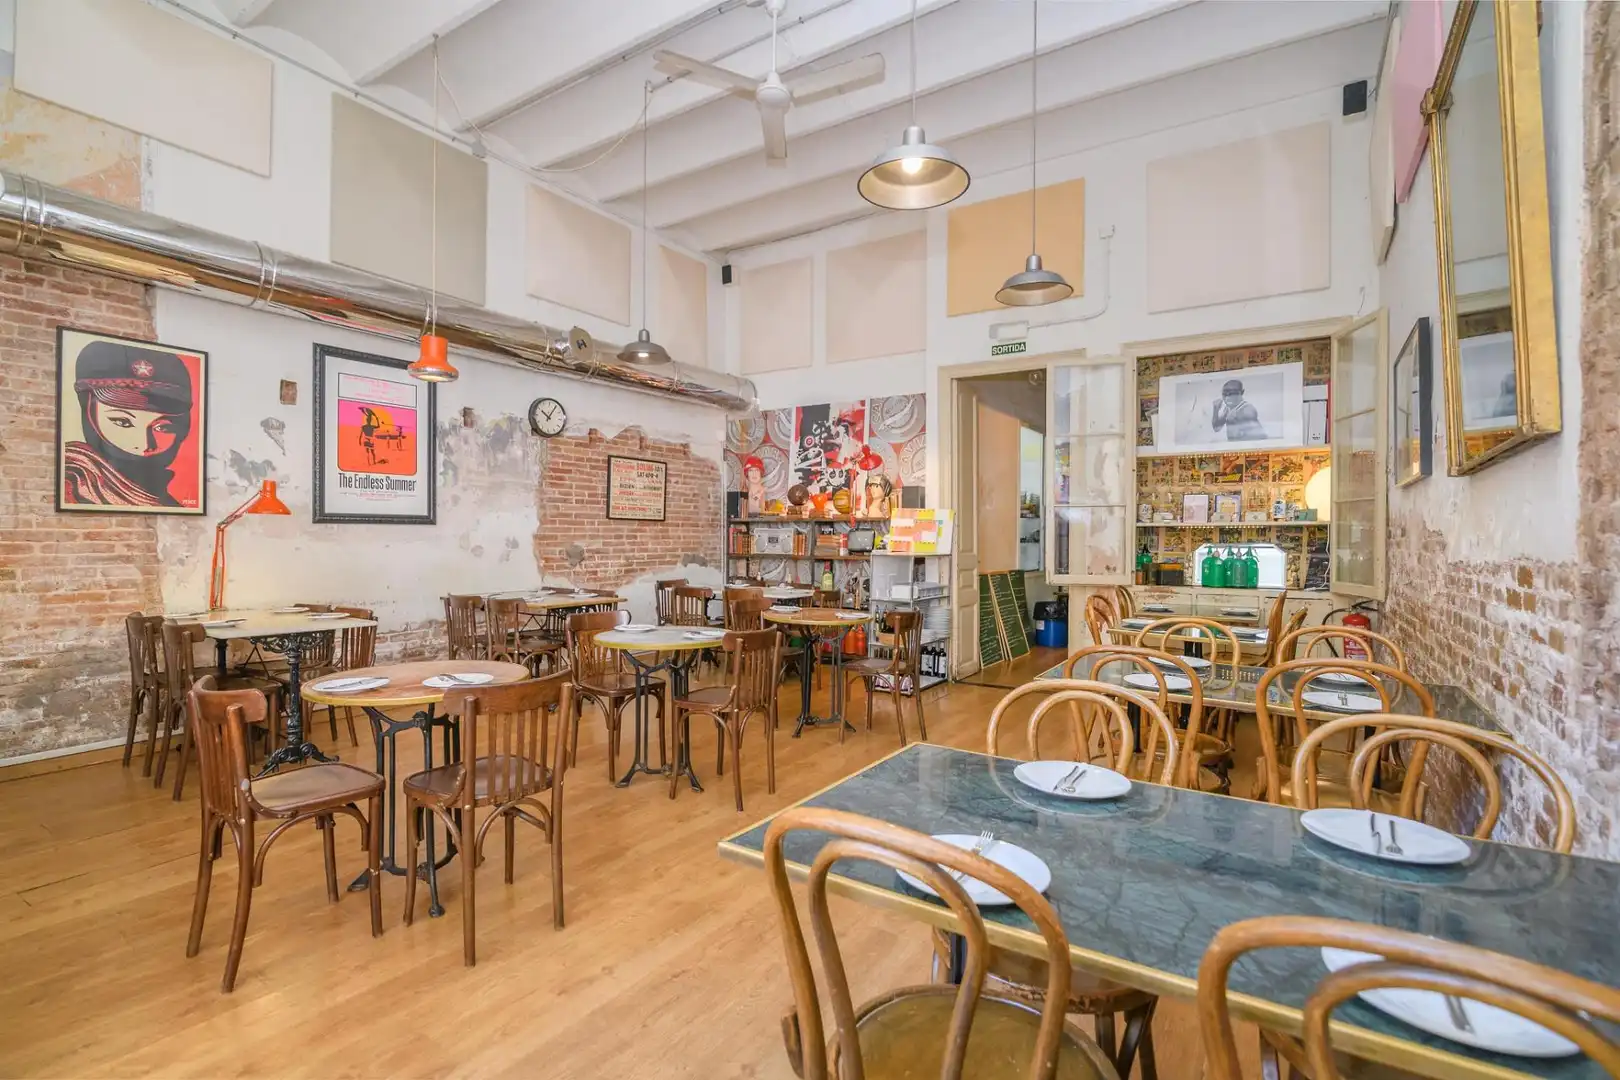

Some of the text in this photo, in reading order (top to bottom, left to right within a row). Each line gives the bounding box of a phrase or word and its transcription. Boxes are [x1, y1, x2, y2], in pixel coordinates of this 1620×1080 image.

[992, 343, 1026, 355] SORTIDA
[338, 472, 417, 492] The Endless Summer
